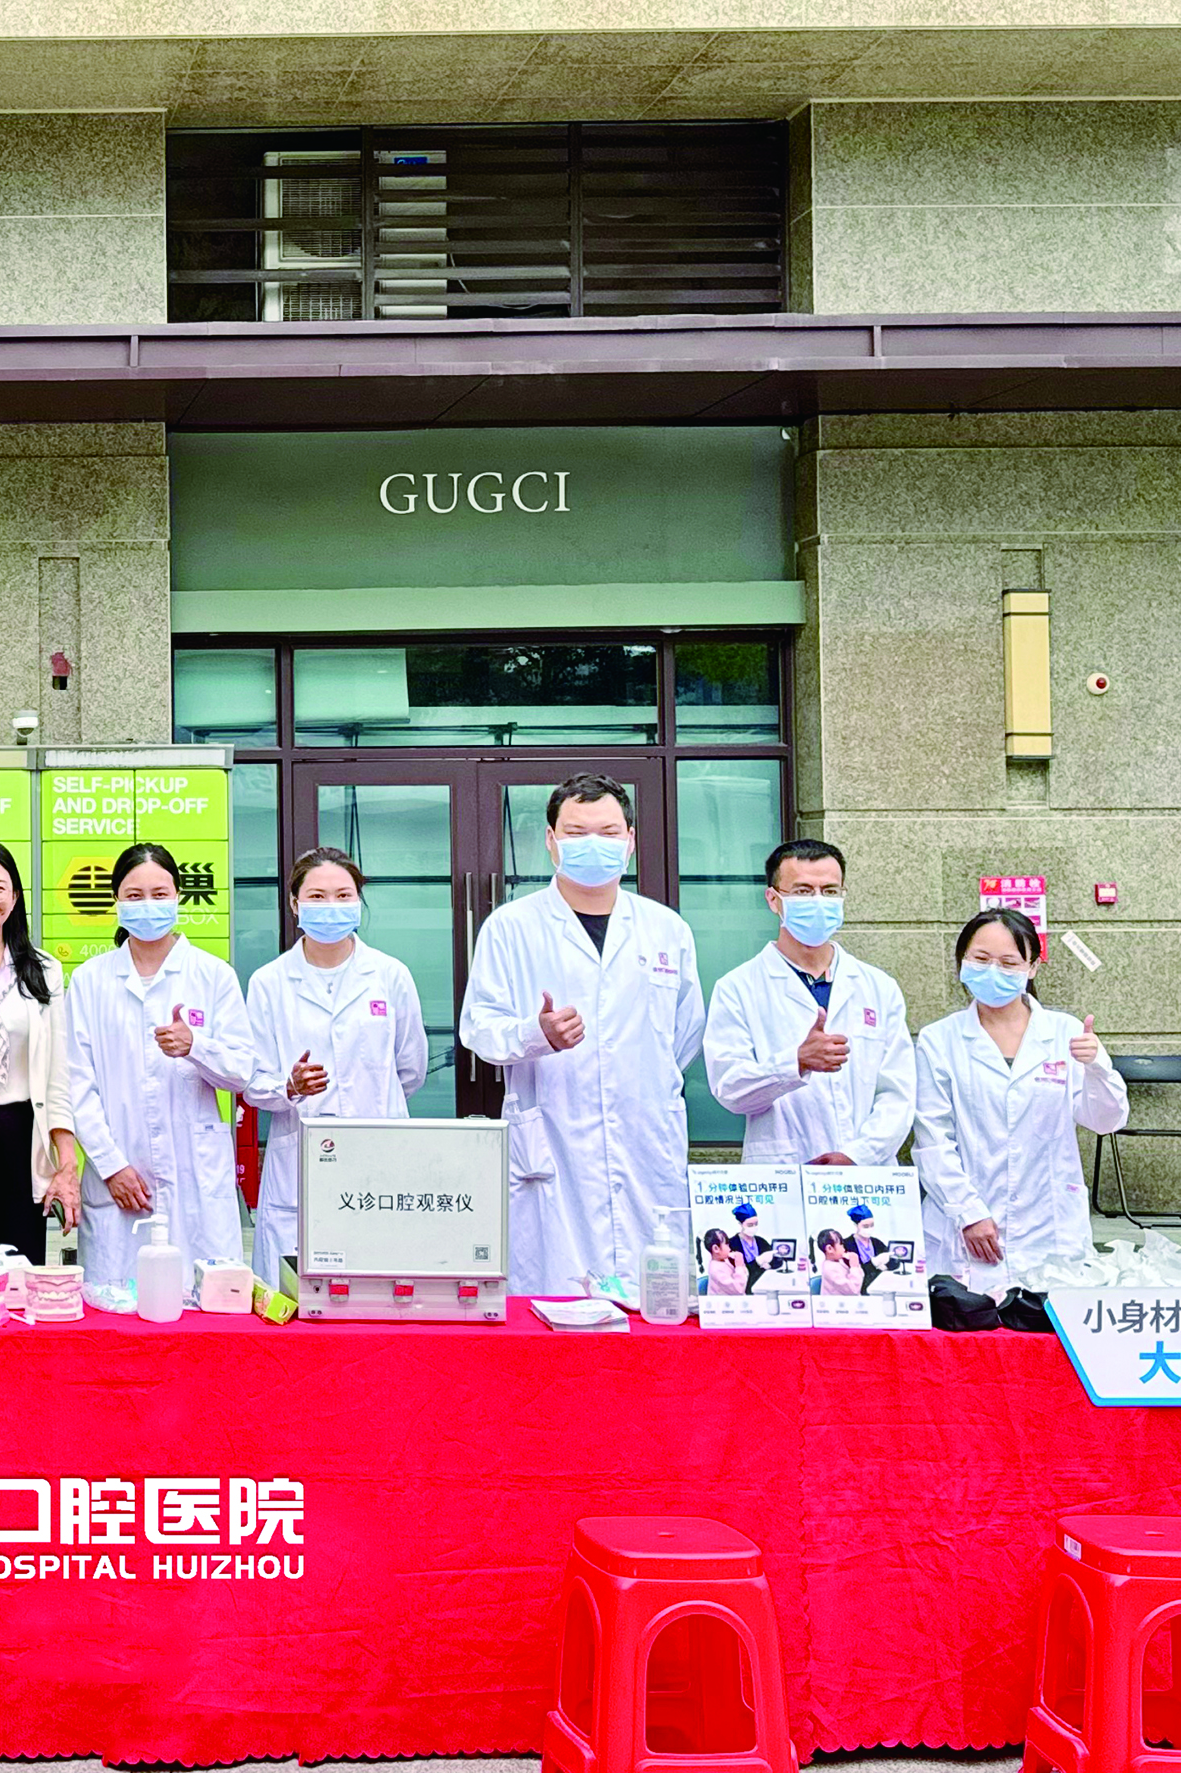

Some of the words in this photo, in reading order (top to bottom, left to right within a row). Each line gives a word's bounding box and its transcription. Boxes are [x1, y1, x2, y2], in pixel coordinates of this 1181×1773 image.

[380, 471, 570, 514] GUGCI
[52, 777, 188, 794] SELF-PICKUP
[52, 797, 97, 814] AND
[102, 797, 209, 814] DROP-OFF
[52, 818, 141, 835] SERVICE
[337, 1190, 474, 1214] 义诊口腔观察仪
[1082, 1299, 1181, 1334] 小身材
[1138, 1340, 1181, 1385] 大
[152, 1555, 306, 1580] HUIZHOU
